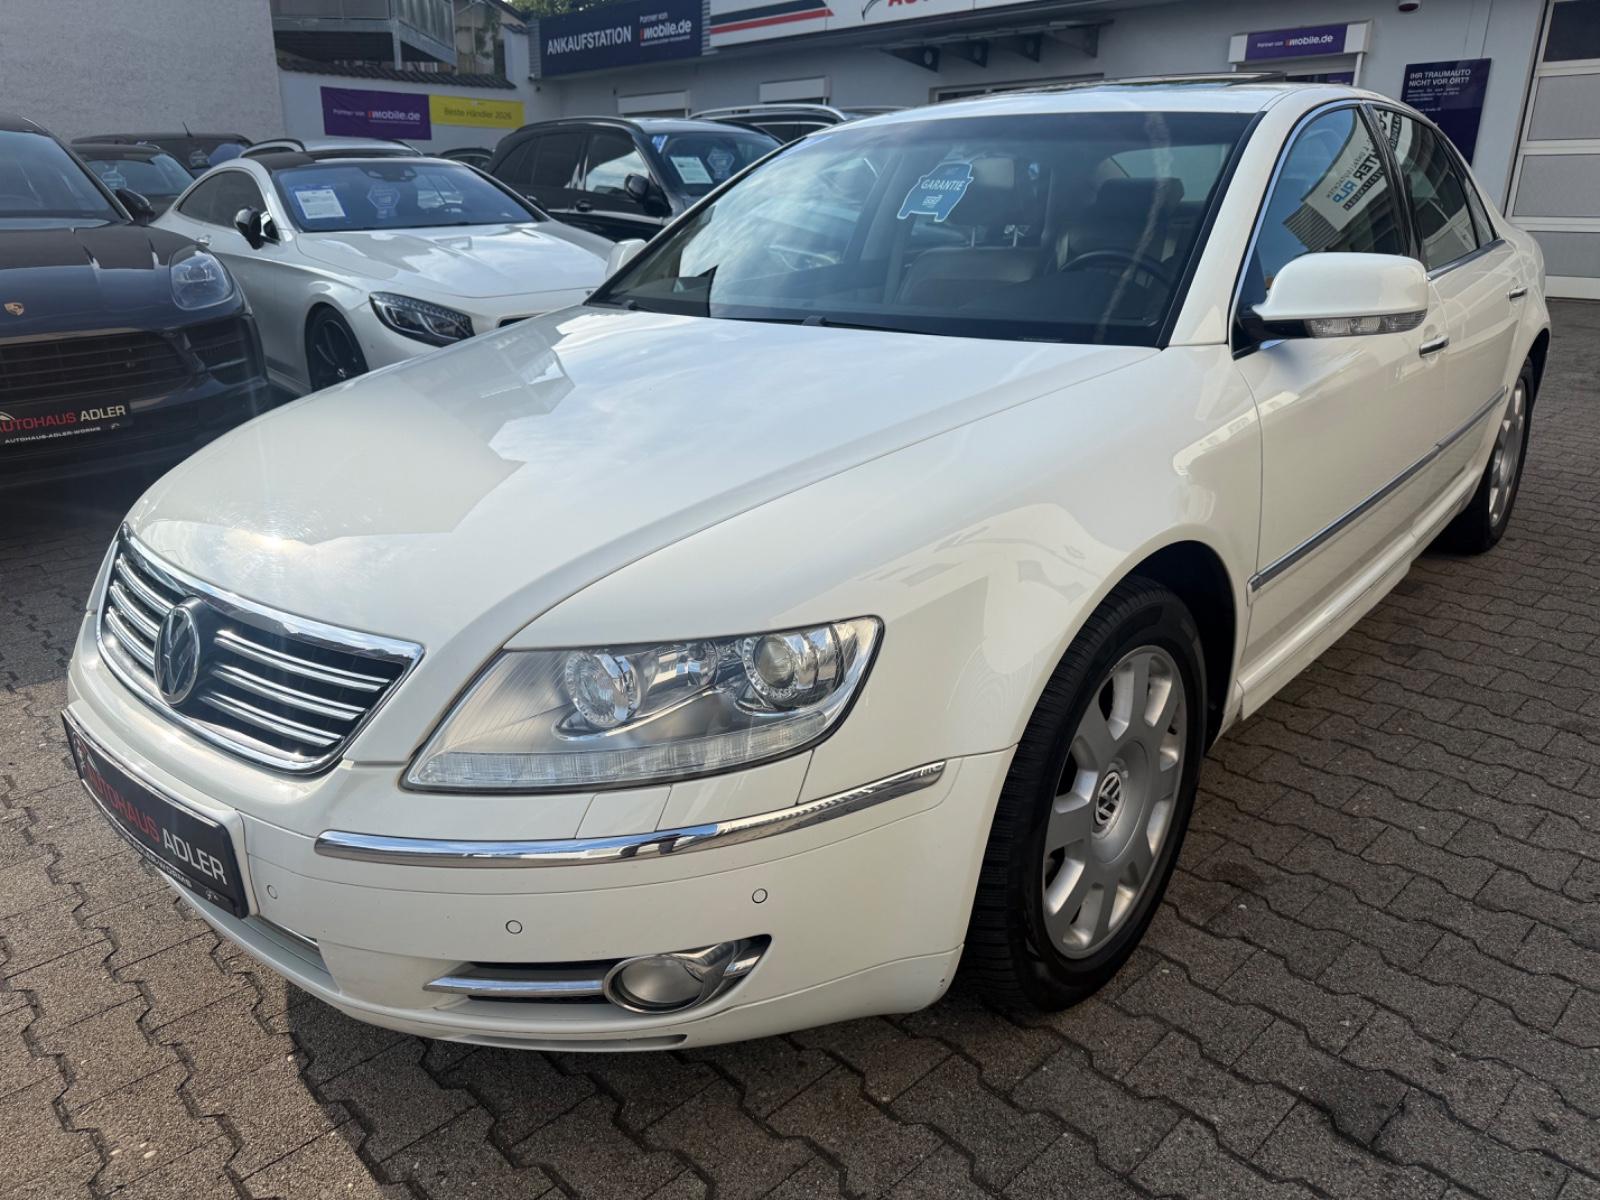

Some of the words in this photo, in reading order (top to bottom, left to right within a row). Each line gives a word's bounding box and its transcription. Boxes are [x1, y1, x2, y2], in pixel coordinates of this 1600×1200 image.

[640, 19, 692, 40] mobile.de
[547, 25, 632, 55] ANKAUFSTATION
[1410, 72, 1423, 80] IHR
[1424, 68, 1471, 78] TRAUMAUTO
[1408, 79, 1430, 87] NICHT
[1432, 78, 1448, 86] VOR
[368, 110, 420, 120] mobile.de
[920, 179, 966, 191] GARANTIE
[0, 412, 77, 432] UTOHAUS
[80, 405, 126, 422] ADLER
[84, 763, 160, 843] AUTOHAUS
[162, 827, 228, 886] ADLER
